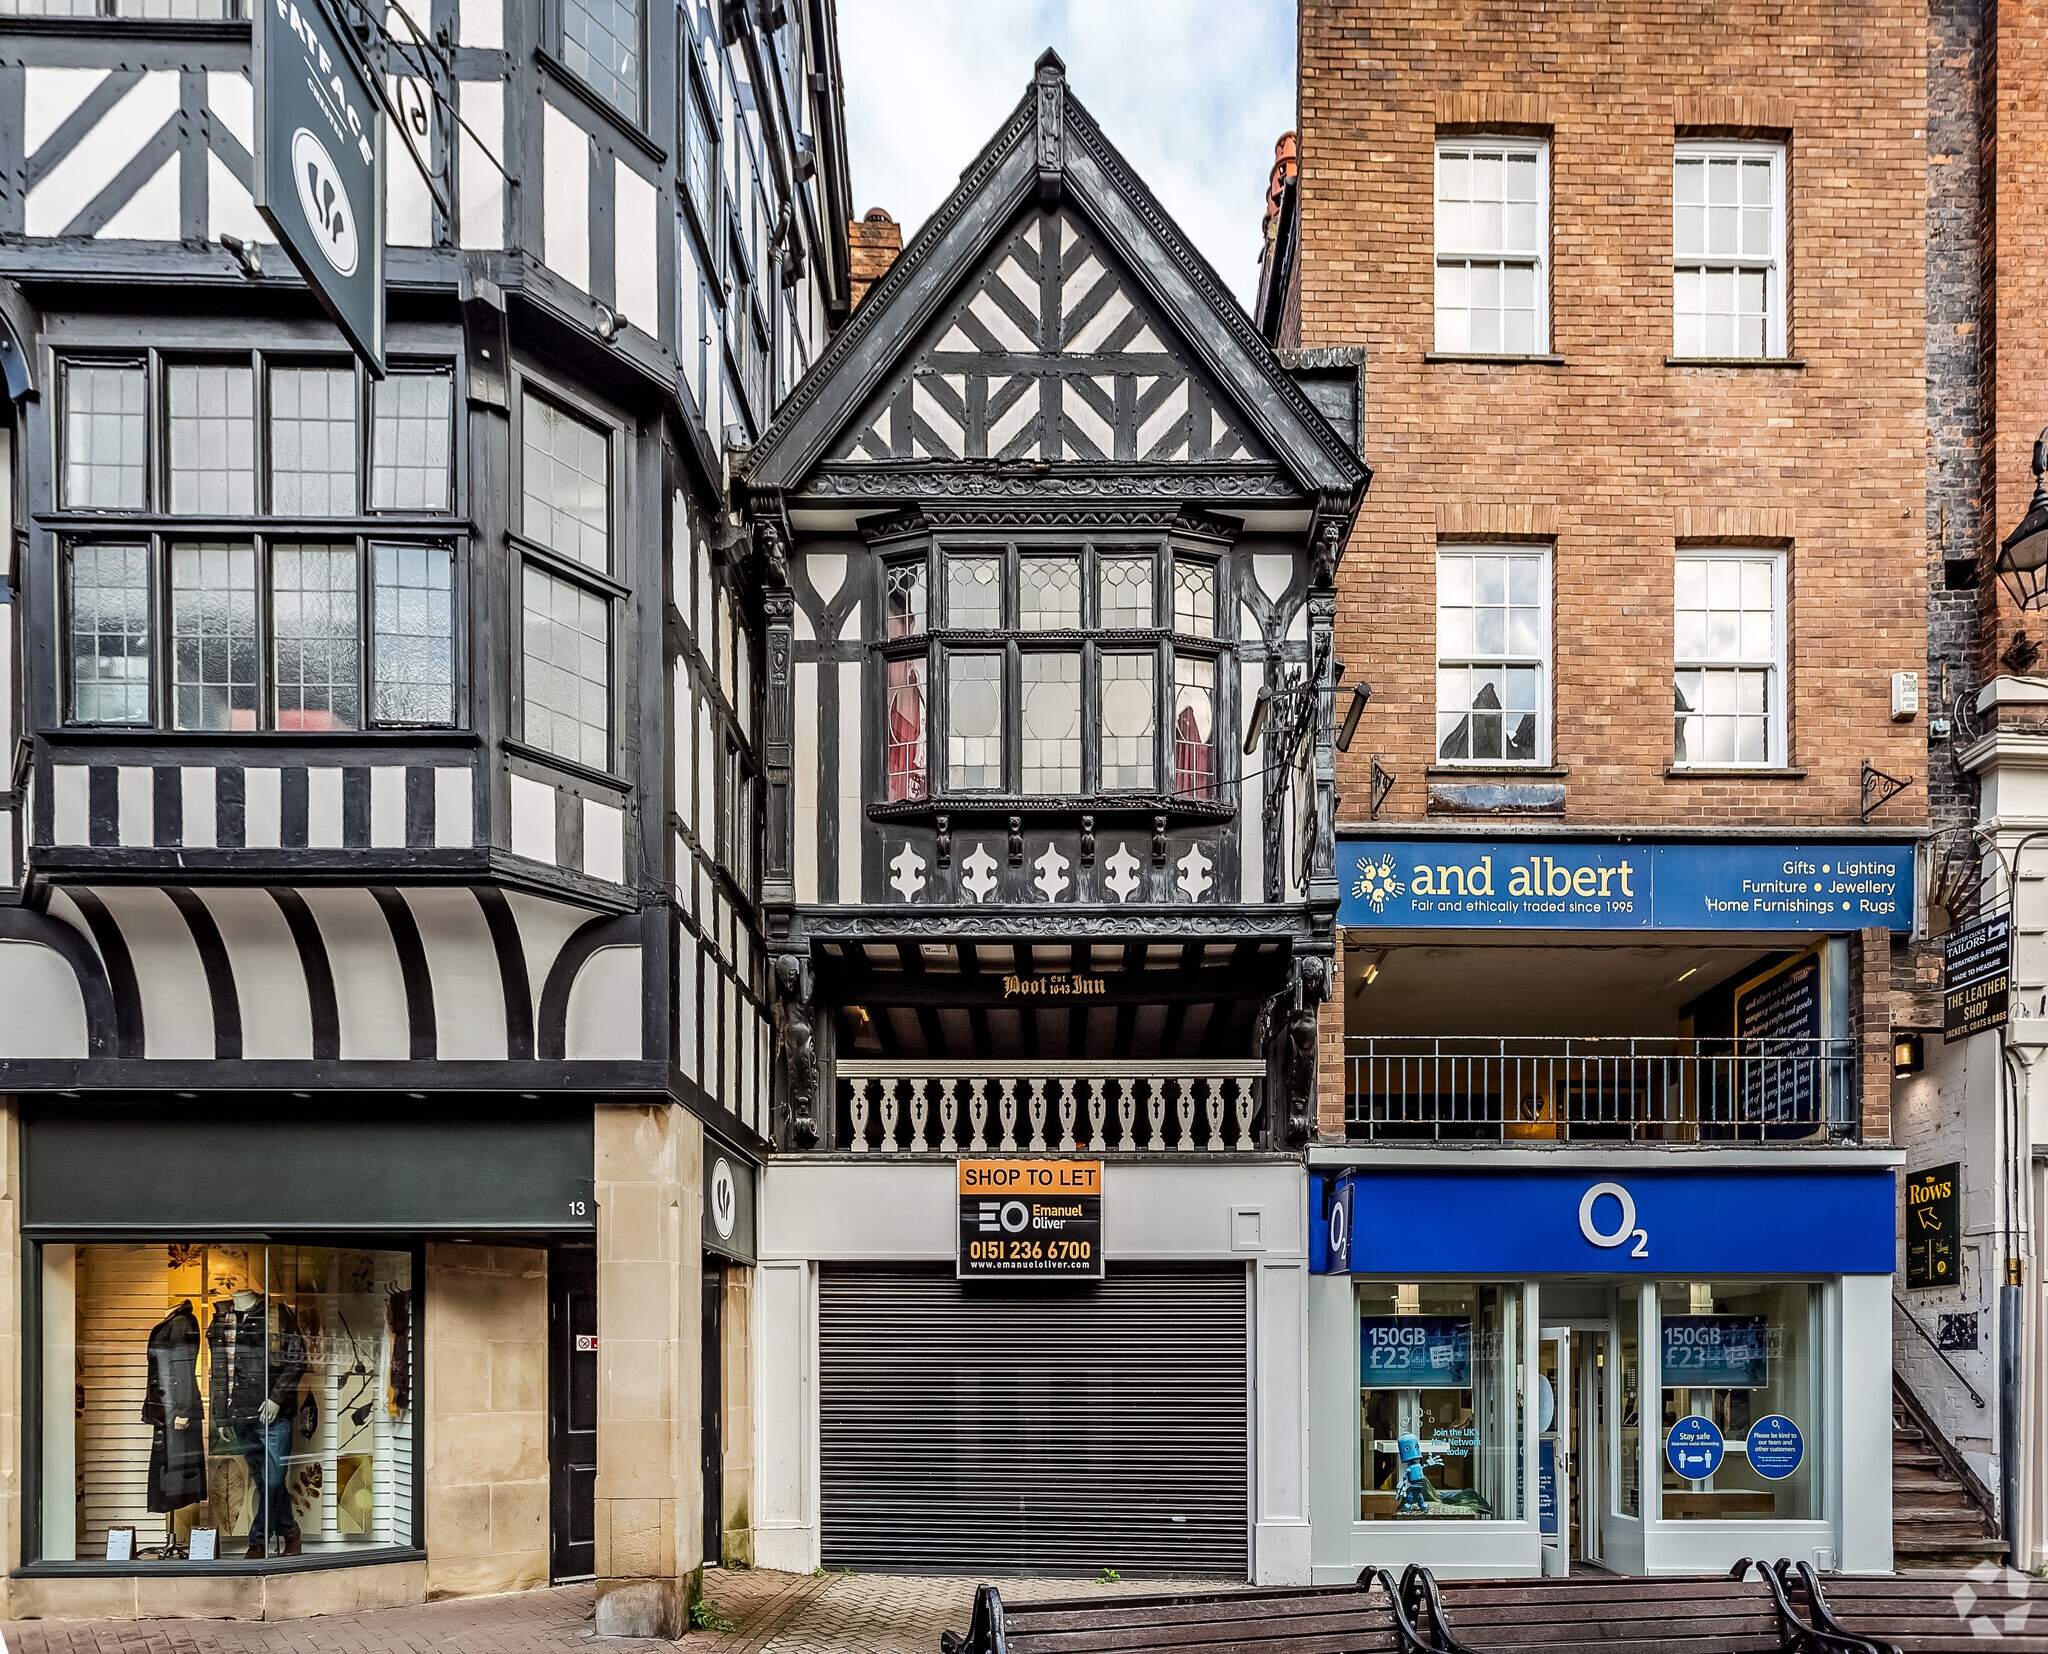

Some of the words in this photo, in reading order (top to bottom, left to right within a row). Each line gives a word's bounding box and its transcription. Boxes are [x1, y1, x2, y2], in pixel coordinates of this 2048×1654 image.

[1411, 855, 1494, 896] and
[1508, 856, 1634, 897] albert
[1782, 861, 1815, 874] Gifts
[1837, 862, 1896, 876] Lighting
[1742, 880, 1807, 893] Furniture
[1828, 880, 1896, 895] Jewellery
[1412, 900, 1434, 911] Fair
[1437, 900, 1462, 912] and
[1466, 900, 1518, 914] ethically
[1523, 900, 1564, 912] traded
[1569, 901, 1601, 912] since
[1606, 901, 1633, 913] 1995
[1708, 899, 1749, 912] Home
[1754, 898, 1834, 914] Furnishings
[1860, 899, 1895, 914] Rugs
[1946, 934, 1986, 958] TAILORS
[1946, 953, 1980, 972] ALTERATIONS
[1986, 942, 2008, 956] REPAIRS
[1952, 972, 1967, 982] MADE
[1968, 968, 1975, 976] TO
[1976, 958, 2000, 973] MEASURE
[1002, 975, 1047, 998] Boot
[1072, 974, 1106, 994] Inn
[1946, 992, 1964, 1010] THE
[1966, 976, 2006, 1004] LEATHER
[1964, 1000, 1988, 1020] SHOP
[1970, 1018, 1986, 1030] COATS
[1992, 1012, 2006, 1024] BAGS
[965, 1168, 1020, 1186] SHOP
[1026, 1168, 1053, 1186] TO
[1060, 1169, 1096, 1186] LET
[568, 1201, 586, 1216] 13
[1032, 1204, 1082, 1216] Emanuel
[1032, 1216, 1066, 1230] Oliver
[970, 1241, 1004, 1259] 0151
[1010, 1241, 1042, 1259] 236
[1048, 1241, 1090, 1259] 6700
[970, 1260, 1090, 1268] www.emanueloliver.com
[1369, 1328, 1426, 1346] 150GB
[1664, 1328, 1721, 1345] 150GB
[1370, 1346, 1410, 1368] £23
[1665, 1346, 1706, 1368] £23
[1433, 1428, 1448, 1436] Join
[1450, 1428, 1462, 1436] the
[1680, 1432, 1694, 1442] Stay
[1696, 1432, 1710, 1440] safe
[1448, 1438, 1482, 1446] Network
[1446, 1448, 1468, 1458] today
